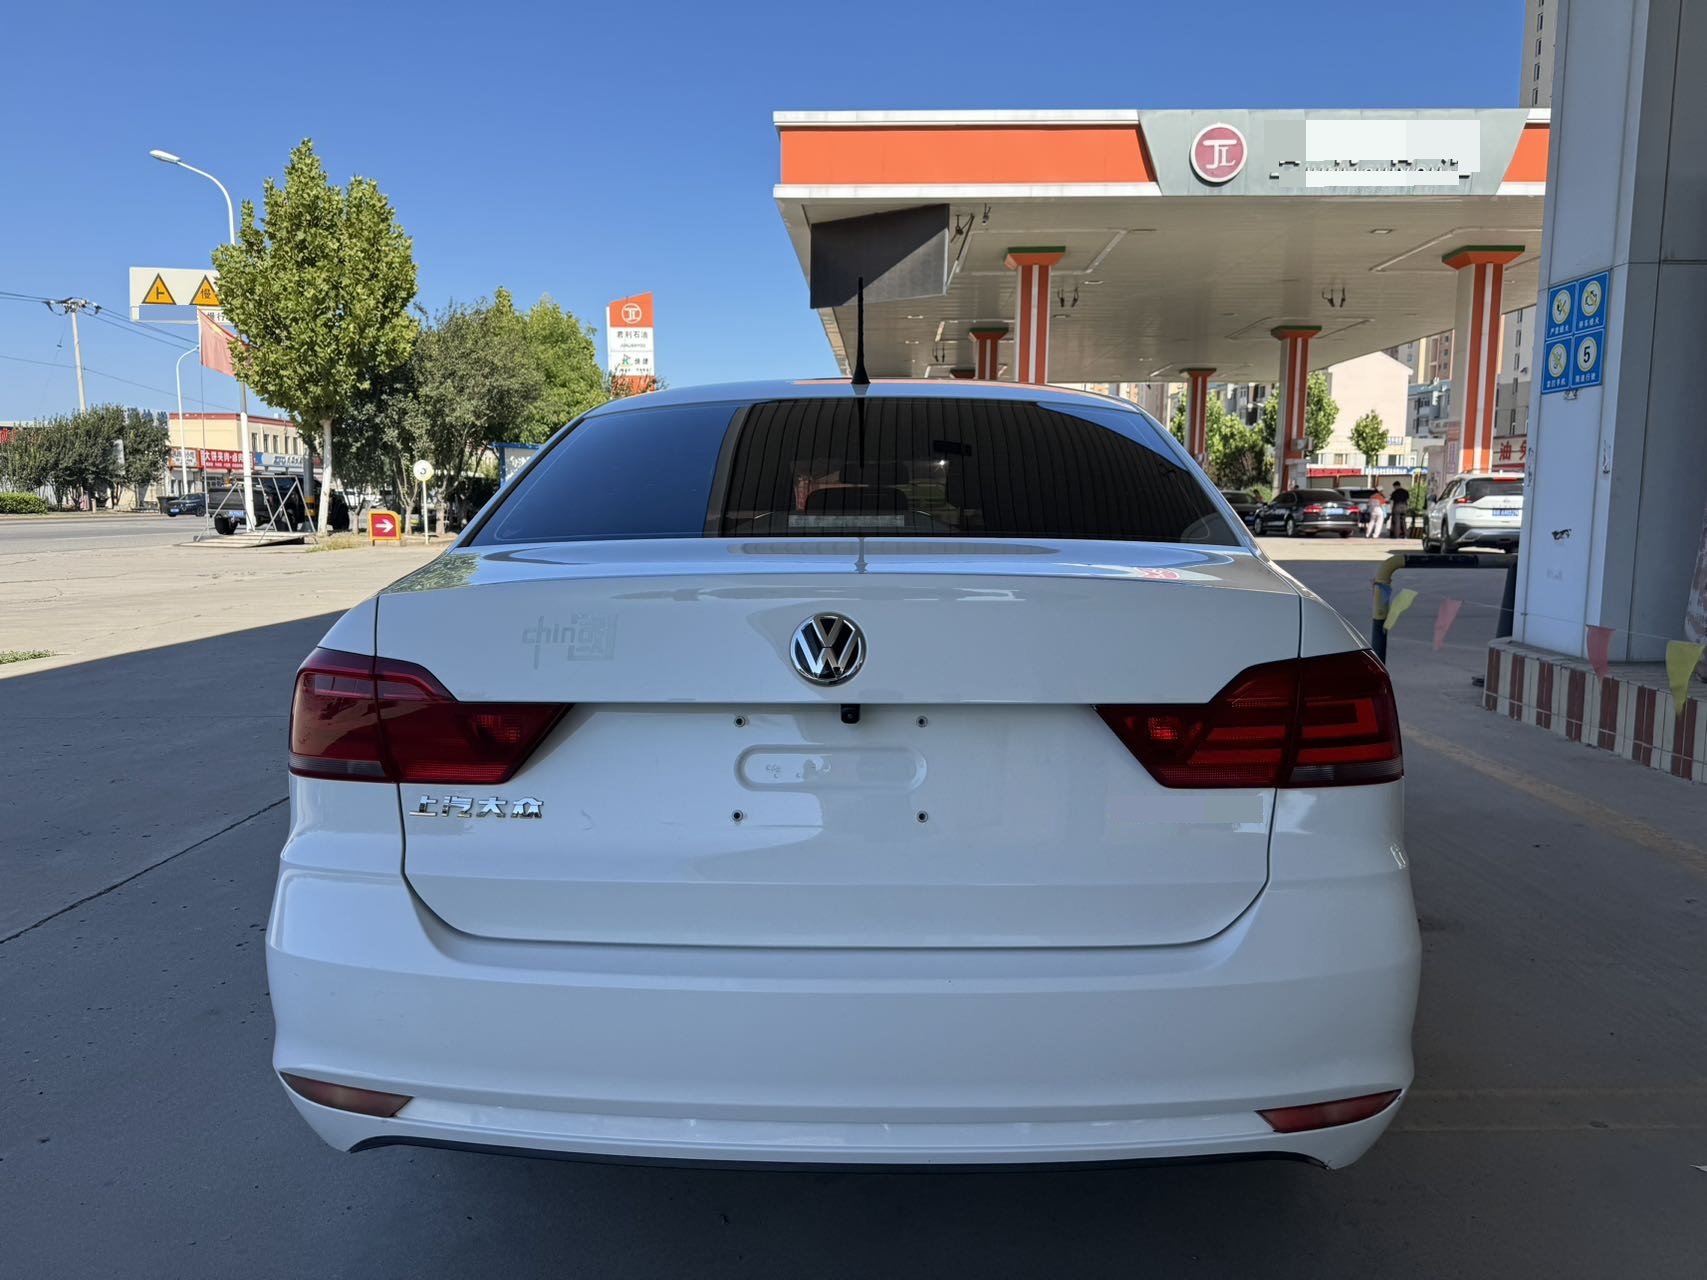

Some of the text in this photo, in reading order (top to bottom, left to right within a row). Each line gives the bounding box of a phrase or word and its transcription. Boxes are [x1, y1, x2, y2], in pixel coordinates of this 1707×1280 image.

[200, 288, 211, 299] 慢
[1583, 345, 1591, 363] 5
[409, 795, 544, 819] 上汽大众
